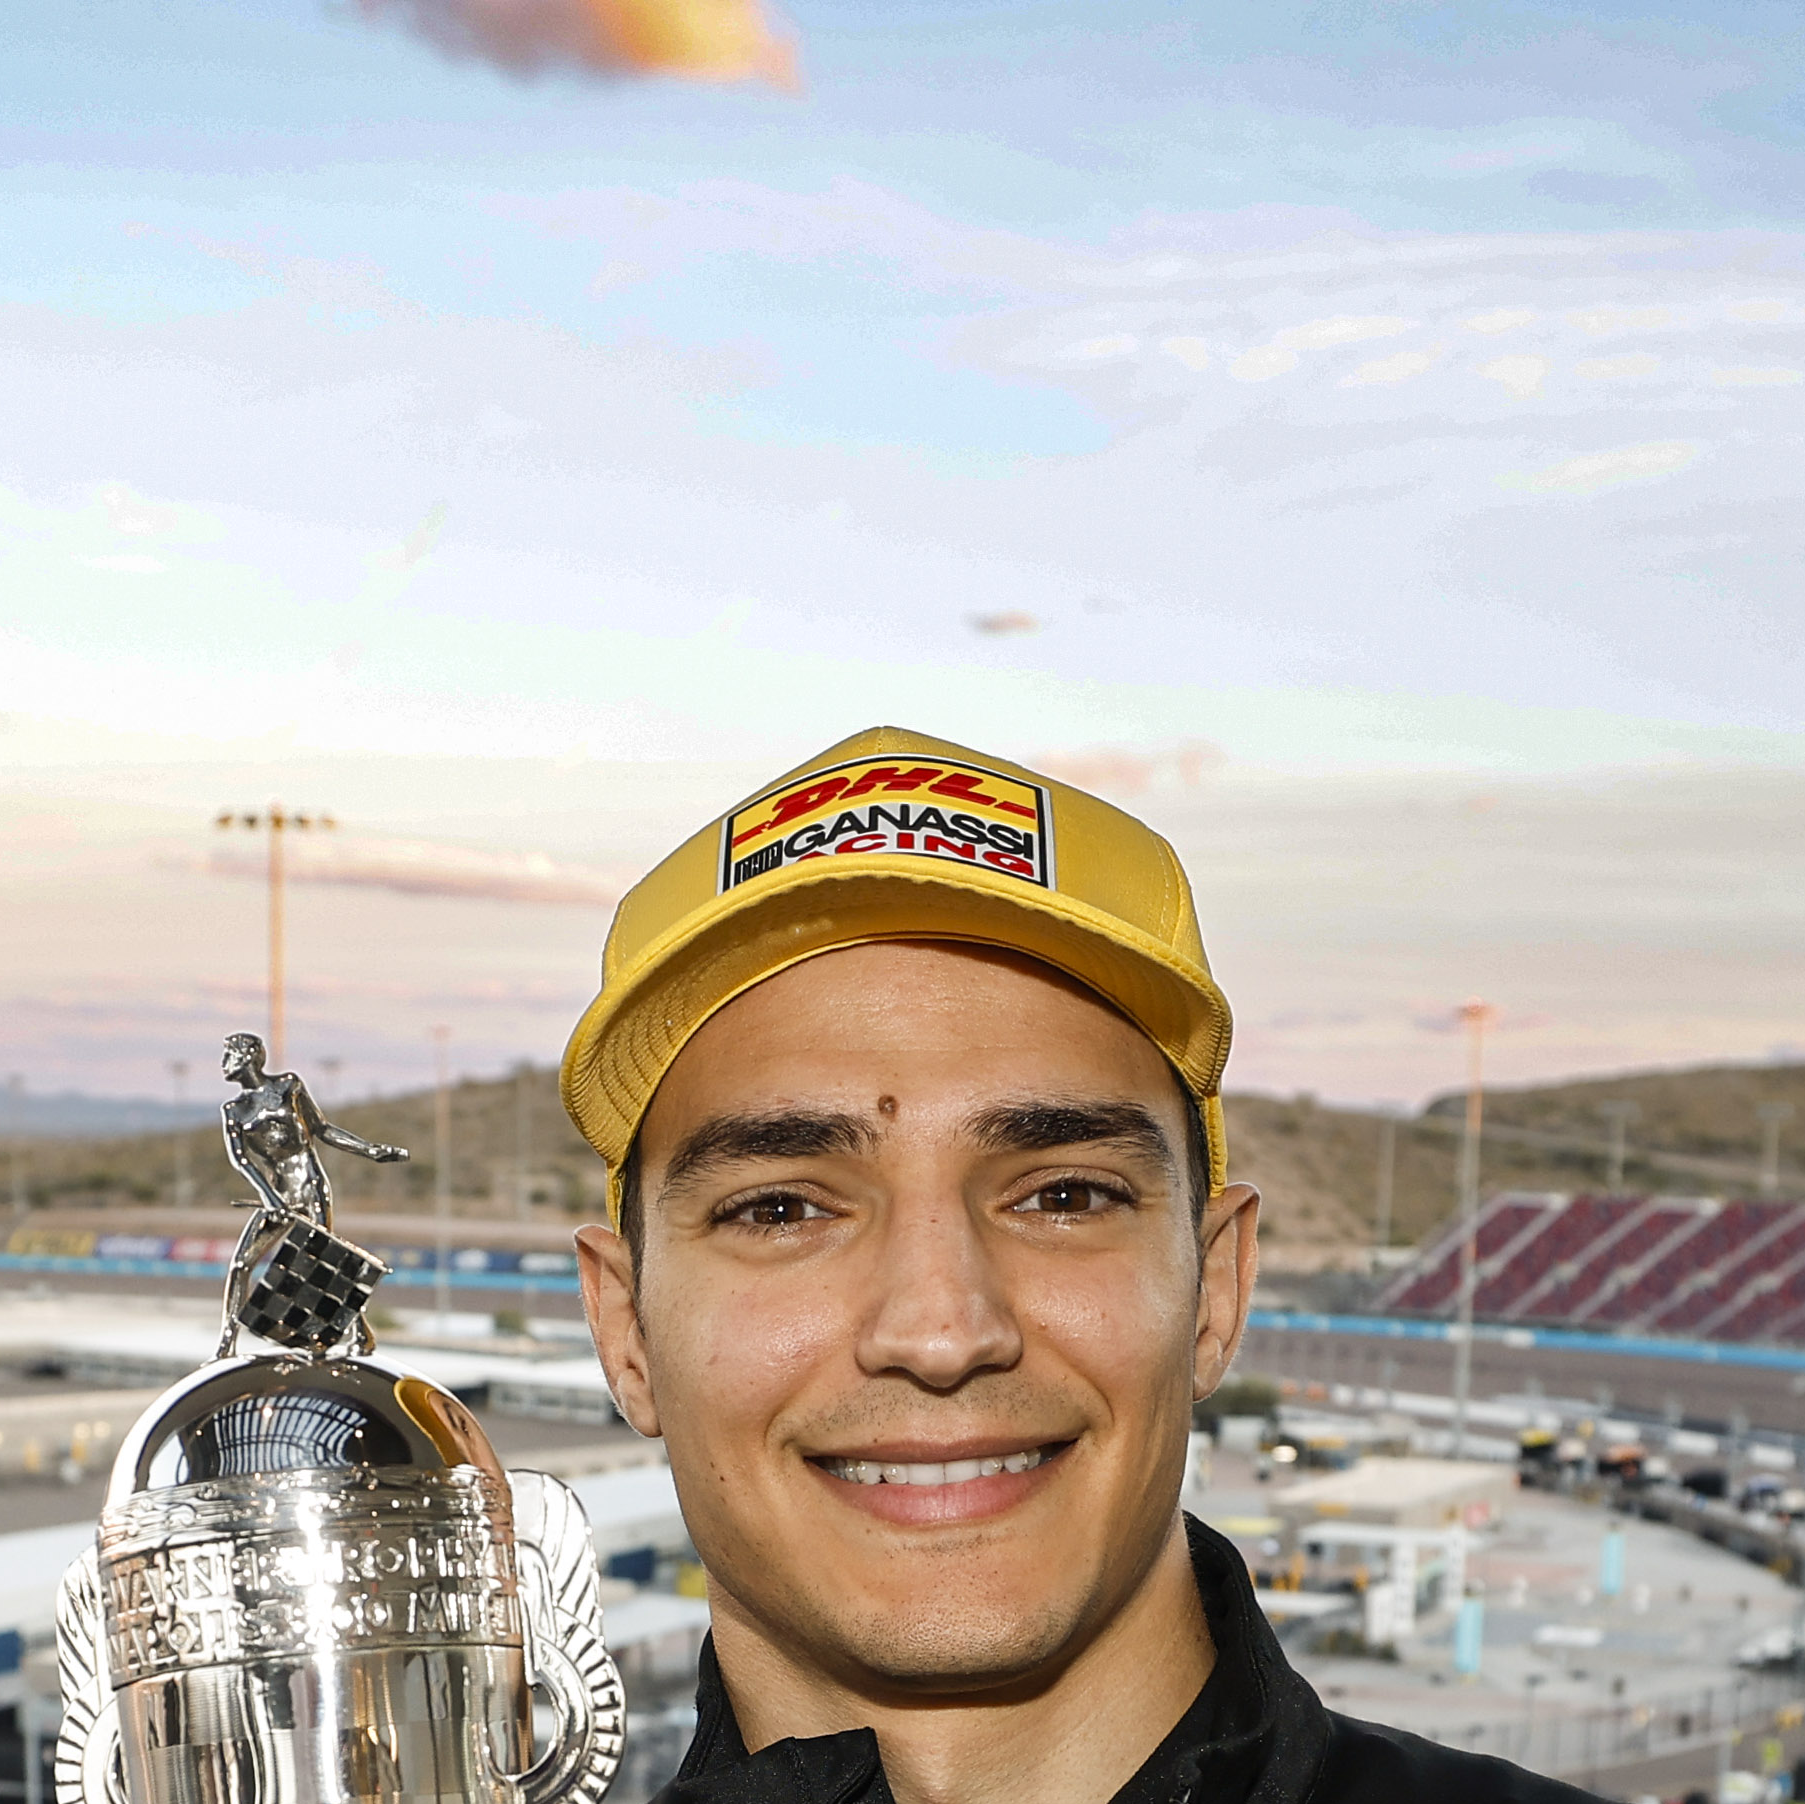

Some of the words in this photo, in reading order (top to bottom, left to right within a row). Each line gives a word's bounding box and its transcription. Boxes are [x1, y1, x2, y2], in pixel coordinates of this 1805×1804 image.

[765, 767, 997, 830] DHL
[784, 803, 1035, 861] GANASSI
[796, 832, 1035, 878] CING
